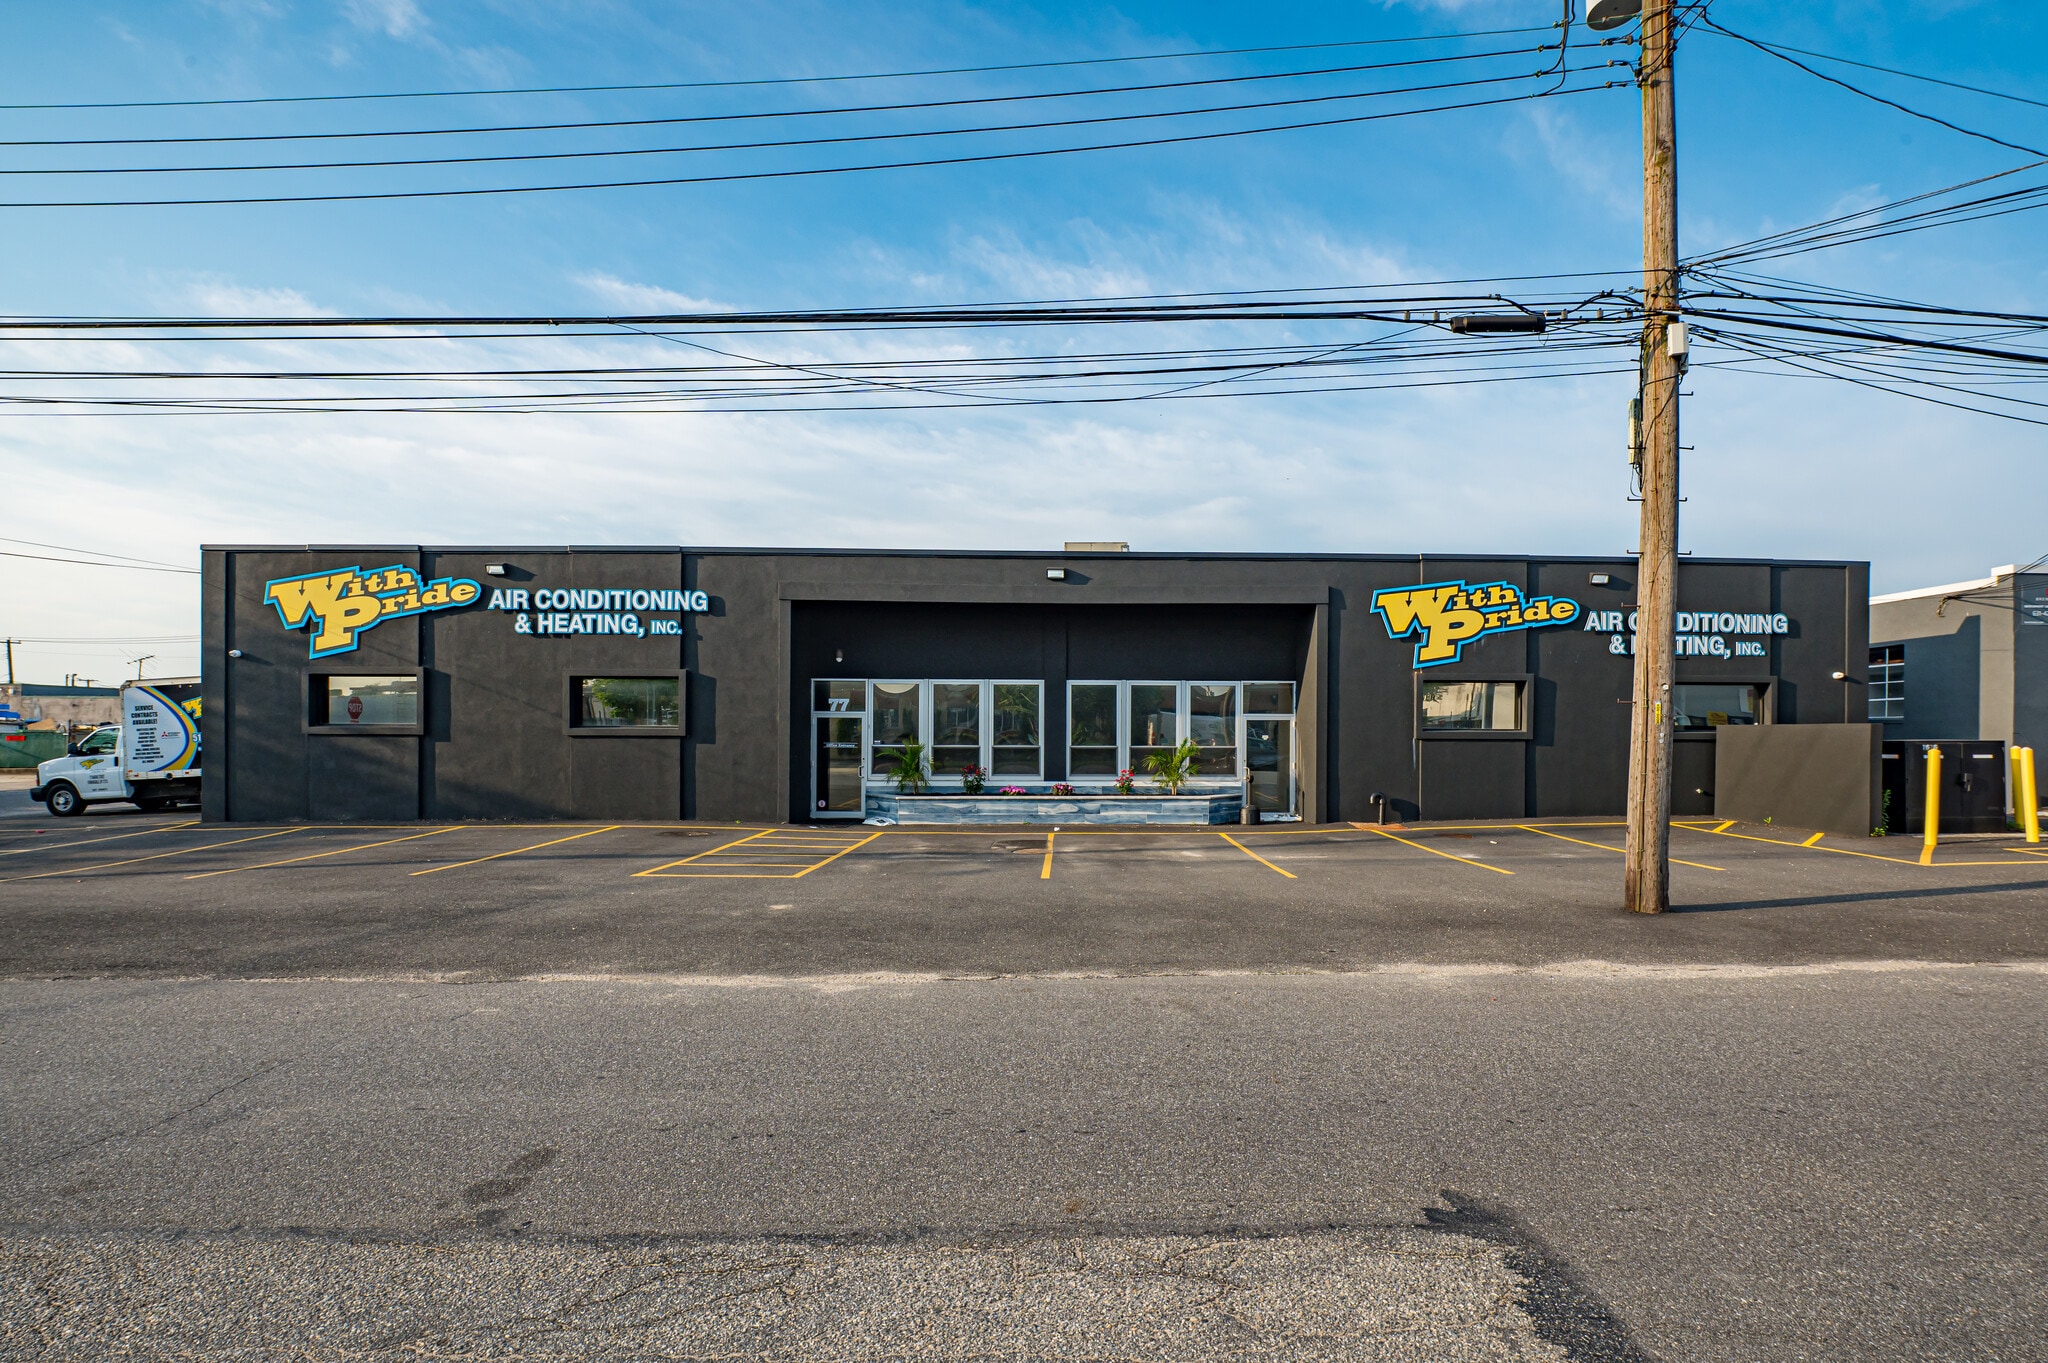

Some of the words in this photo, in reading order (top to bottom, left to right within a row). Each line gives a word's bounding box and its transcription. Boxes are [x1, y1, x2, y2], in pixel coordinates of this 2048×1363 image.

[268, 569, 416, 624] With
[487, 588, 530, 610] AIR
[534, 588, 709, 611] CONDITIONING
[1375, 585, 1518, 634] With
[314, 583, 477, 651] Pride
[514, 612, 533, 634] &
[537, 612, 646, 638] HEATING,
[650, 619, 683, 635] INC.
[1583, 610, 1625, 632] AIR
[1628, 611, 1789, 634] DITIONING
[1418, 600, 1576, 662] Pride
[1608, 633, 1628, 655] &
[1630, 634, 1732, 660] TING,
[1735, 641, 1766, 656] INC.
[131, 711, 158, 719] CONTRACTS
[828, 698, 850, 712] 77
